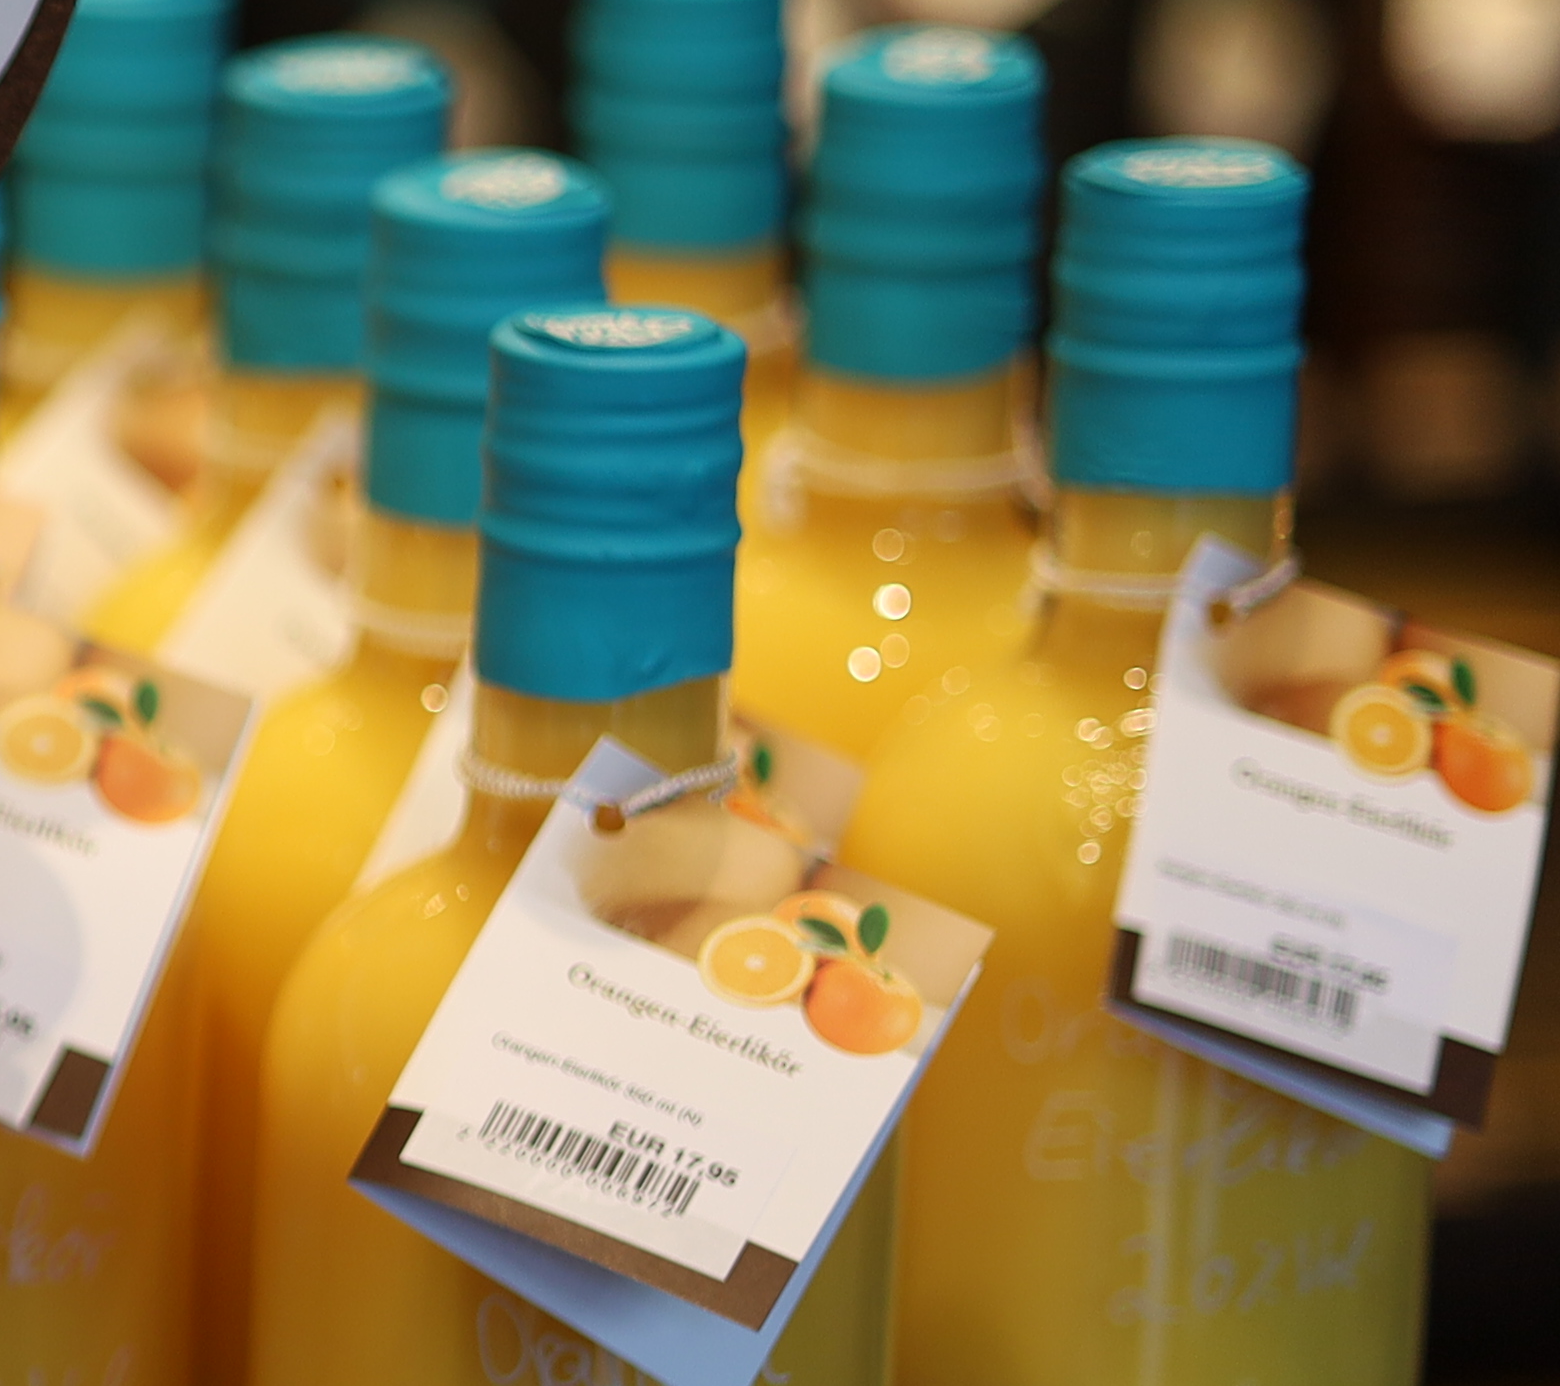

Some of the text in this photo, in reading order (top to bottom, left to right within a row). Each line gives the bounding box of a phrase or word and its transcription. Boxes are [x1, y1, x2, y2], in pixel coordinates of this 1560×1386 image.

[566, 959, 804, 1080] Orangen-Eierlikör
[608, 1119, 741, 1188] EUR 17,95
